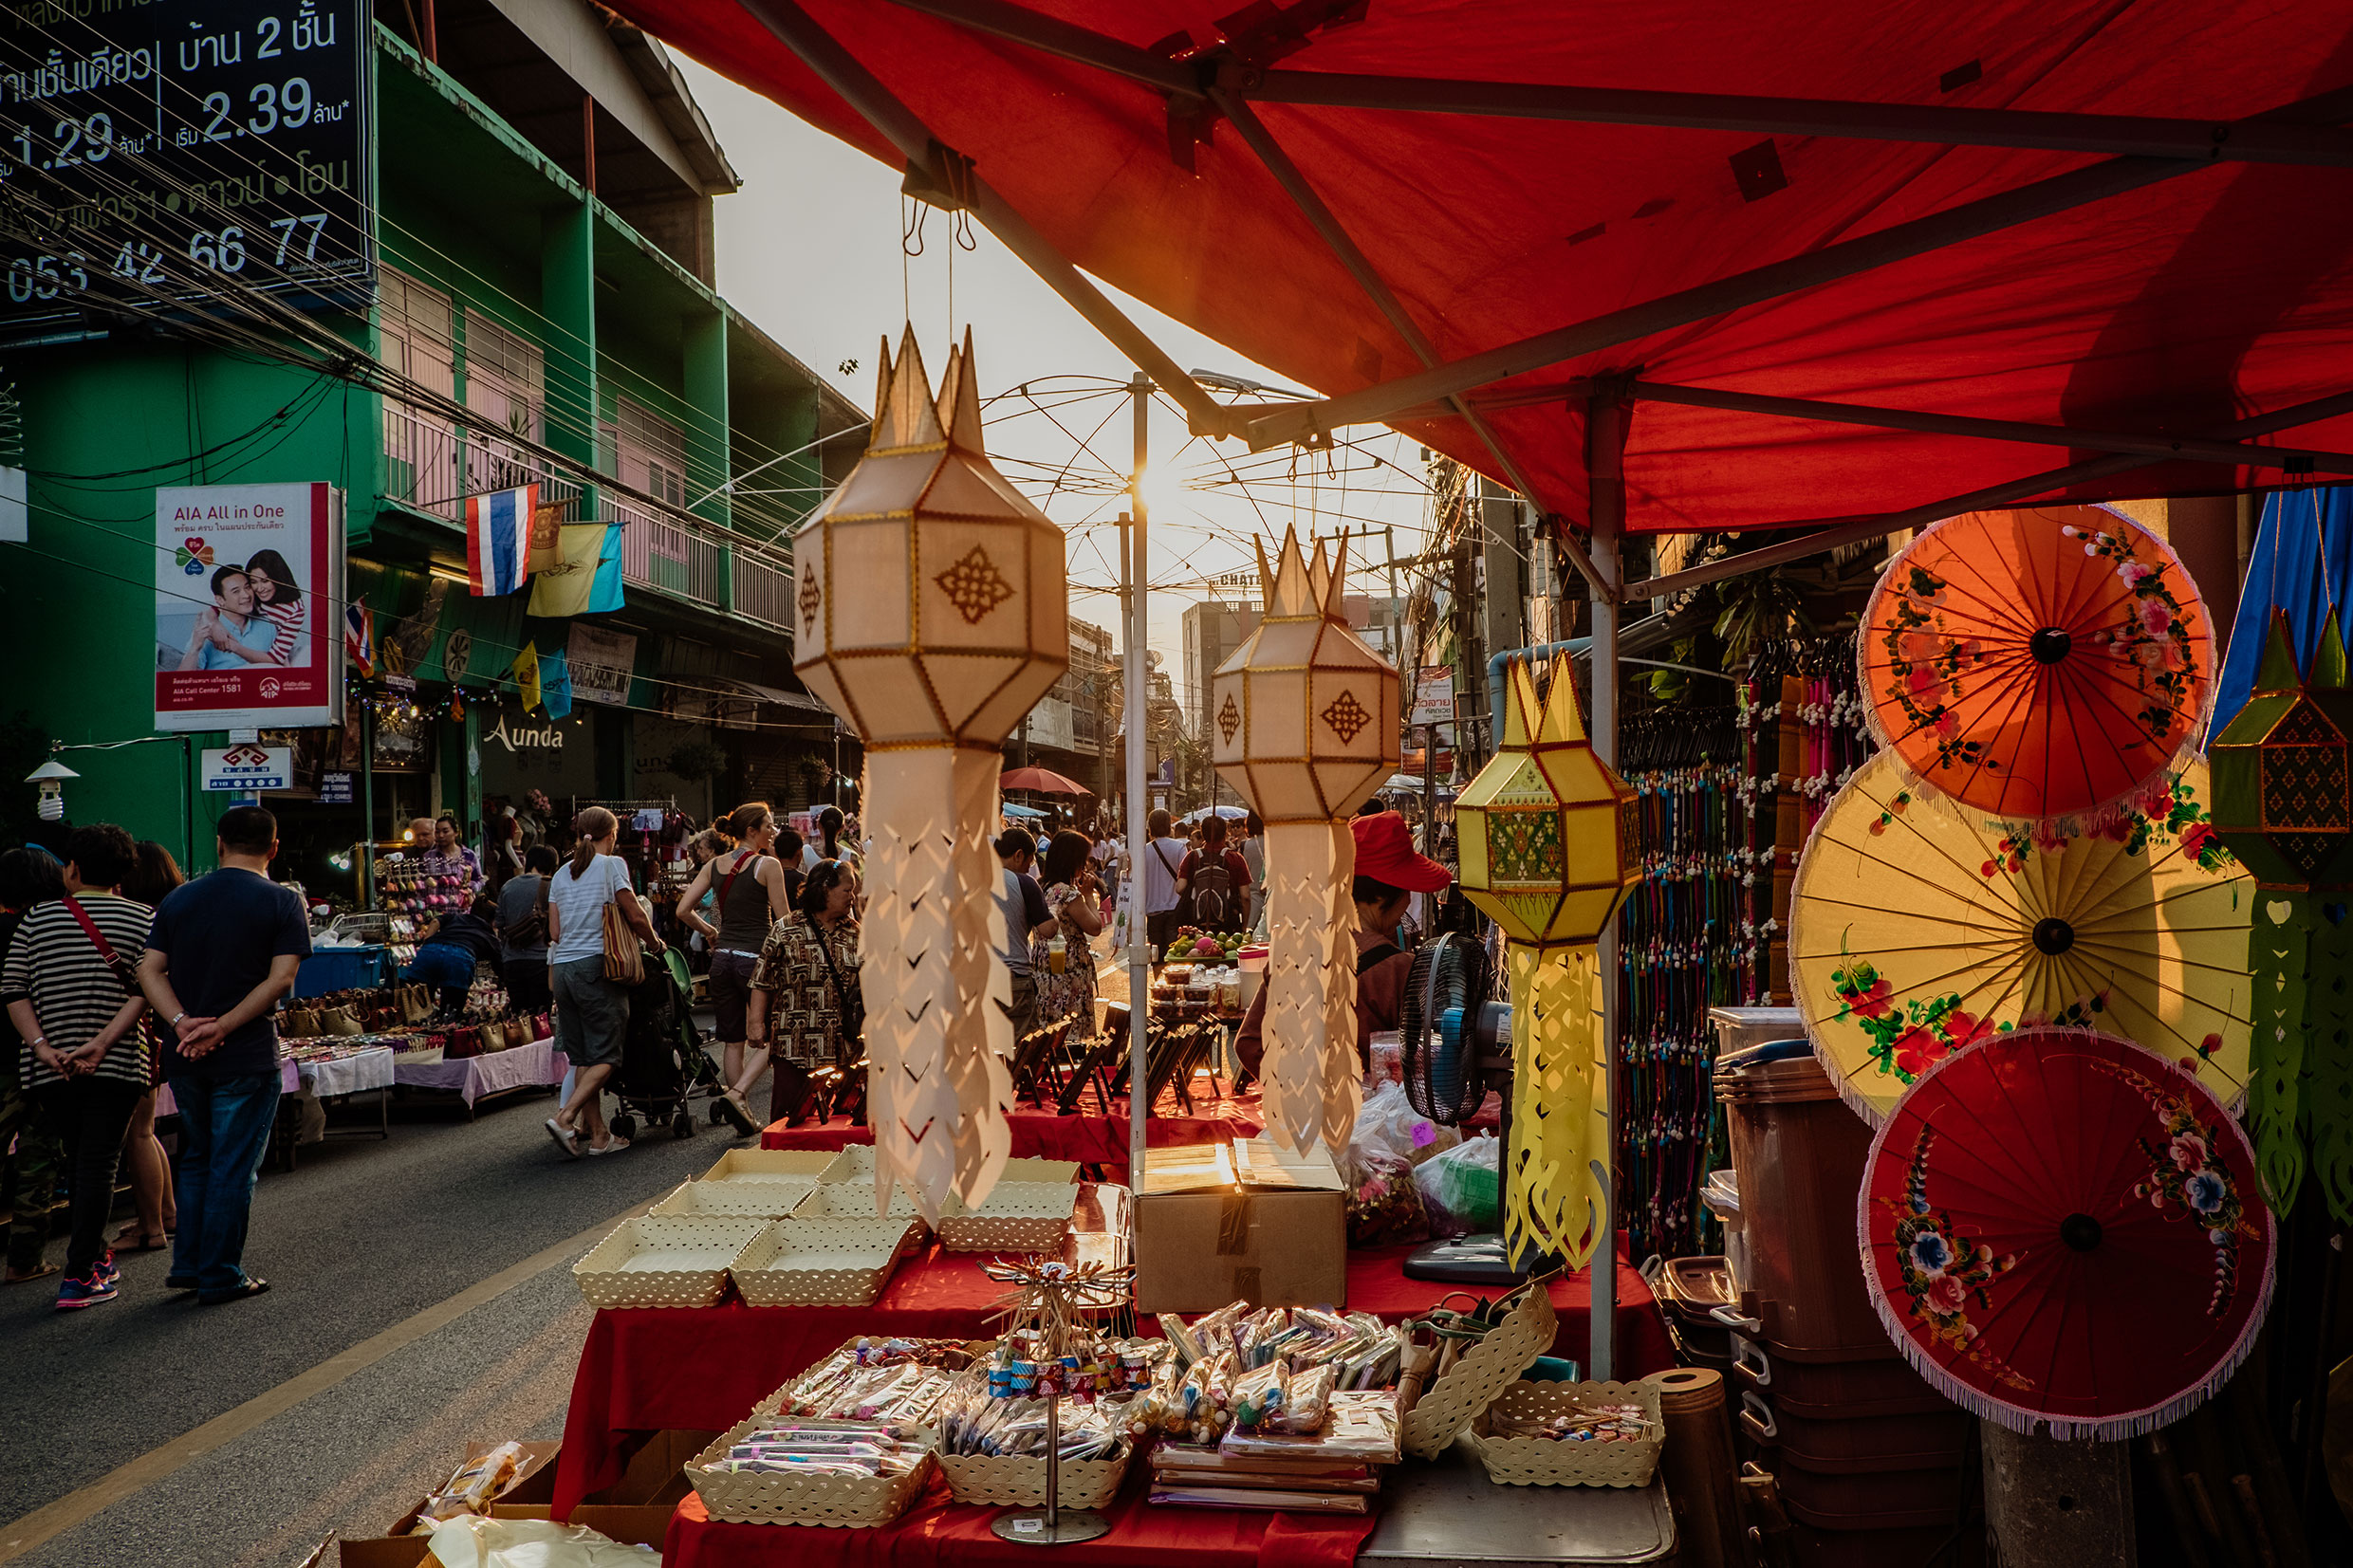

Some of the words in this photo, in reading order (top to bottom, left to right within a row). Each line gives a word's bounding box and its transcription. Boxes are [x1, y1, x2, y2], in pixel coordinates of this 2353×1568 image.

[179, 21, 242, 72] บ้าน
[256, 16, 282, 60] 2
[292, 0, 336, 51] ชั้น
[202, 76, 312, 143] 2.39
[13, 112, 113, 171] 1.29
[295, 149, 350, 195] โอน
[189, 225, 247, 276] 66
[269, 212, 328, 267] 77
[175, 507, 201, 521] AIA
[207, 506, 229, 519] All
[234, 506, 248, 518] in
[253, 505, 284, 518] One
[1221, 574, 1262, 585] CHATE
[222, 684, 241, 692] 1581
[483, 713, 564, 752] Aunda
